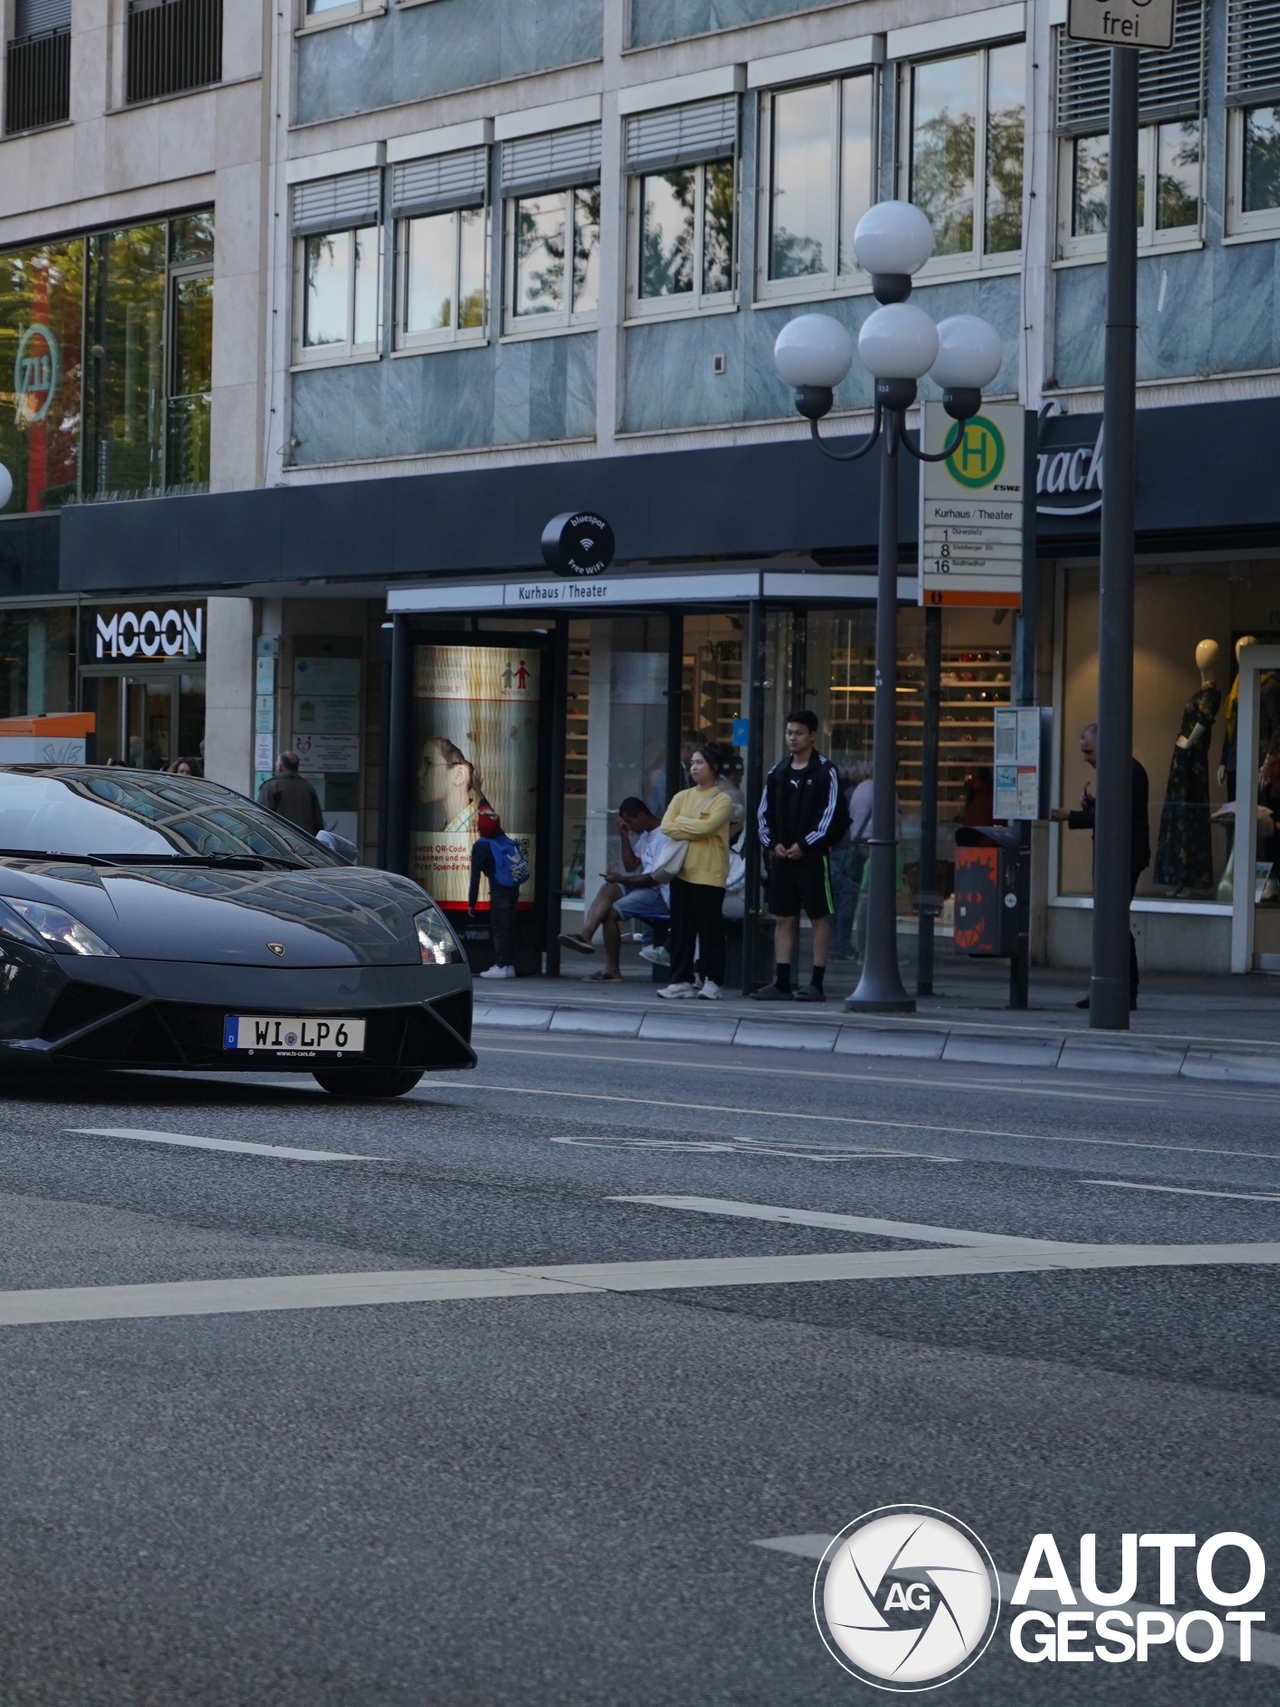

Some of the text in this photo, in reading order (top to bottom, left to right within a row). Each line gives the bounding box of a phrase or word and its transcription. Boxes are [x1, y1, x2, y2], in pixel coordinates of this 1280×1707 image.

[1103, 11, 1139, 37] frei
[962, 431, 987, 472] H
[993, 484, 1020, 492] ESWE
[935, 508, 970, 519] Kurhaus
[978, 509, 1013, 520] Theater
[570, 515, 606, 530] bluespot
[942, 529, 948, 541] 1
[941, 543, 950, 557] 8
[568, 559, 605, 574] Free WiFi
[934, 560, 950, 573] 16
[519, 586, 559, 600] Kurhaus
[569, 583, 607, 598] Theater
[96, 607, 202, 658] MOOON
[415, 845, 467, 853] Jetzt QR-Code
[445, 854, 458, 862] und
[433, 863, 460, 872] Spende
[228, 1035, 235, 1043] D
[255, 1021, 283, 1046] WI
